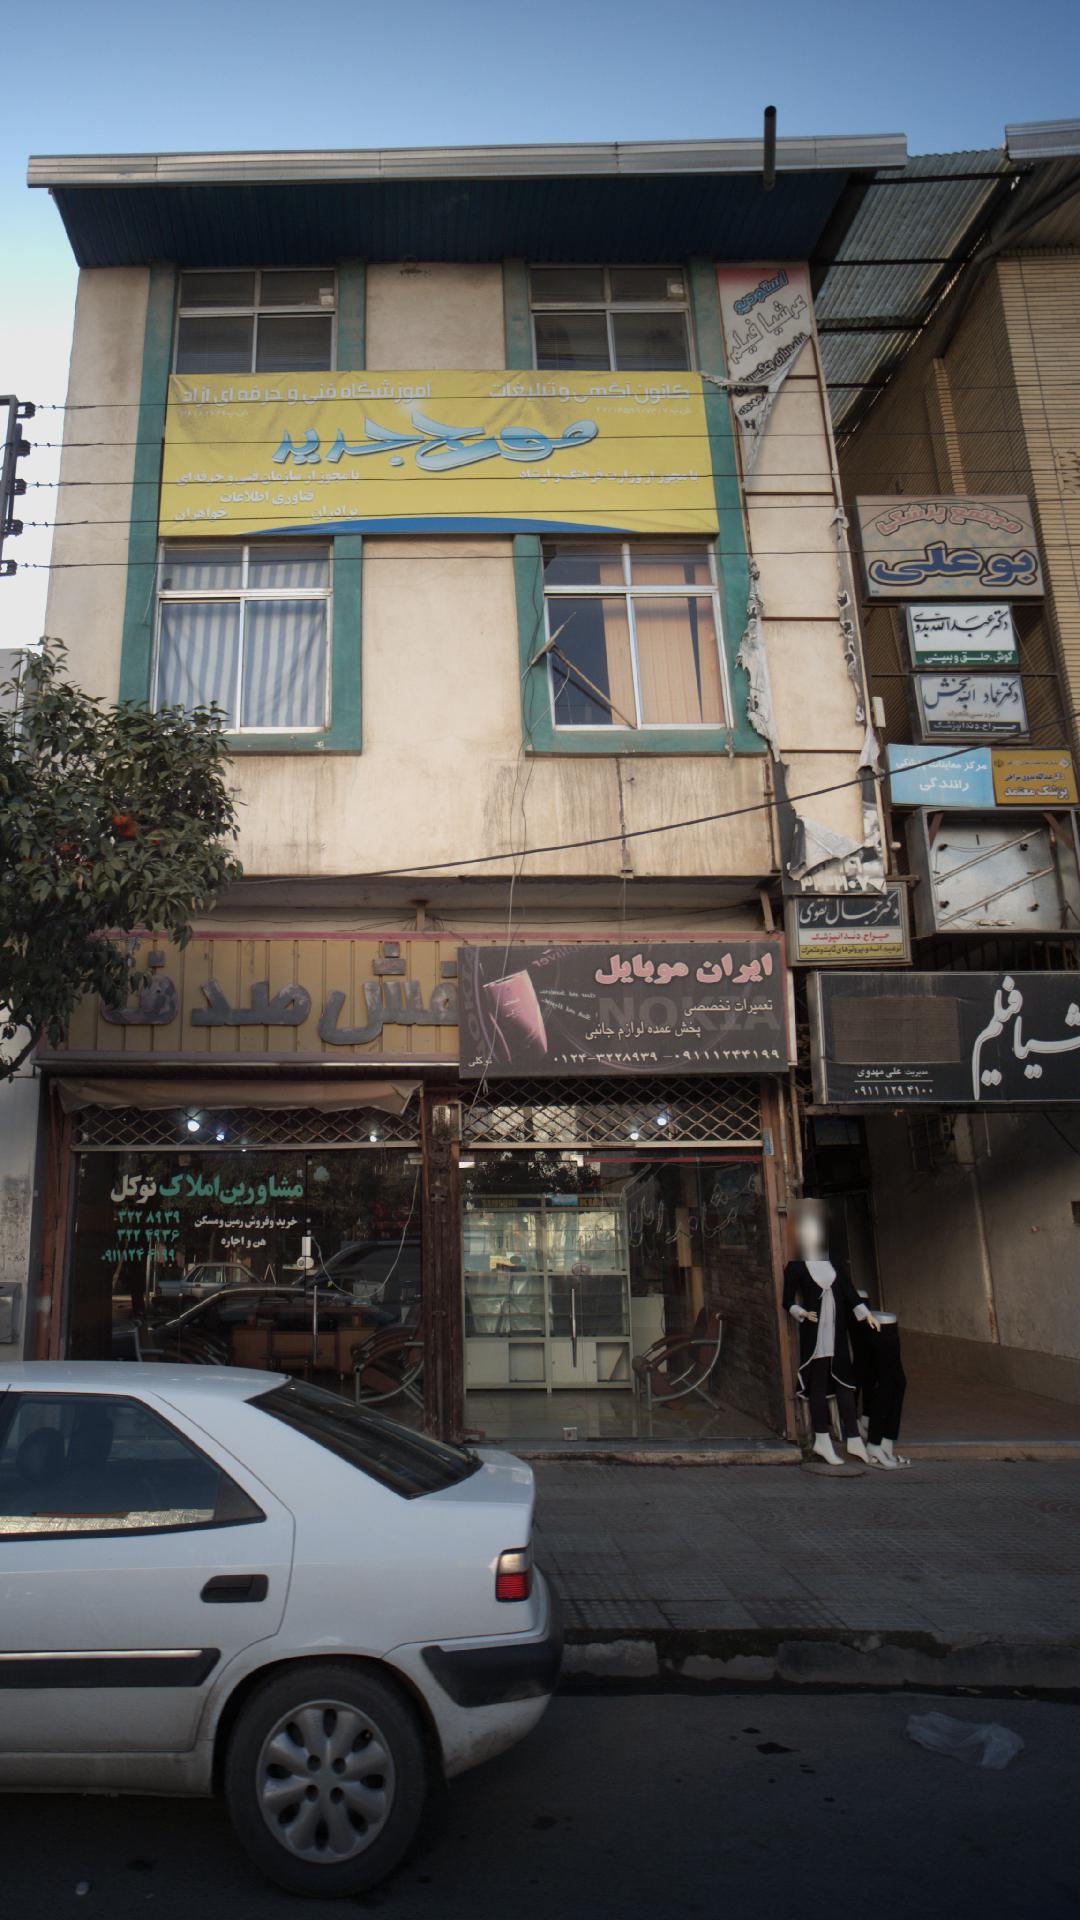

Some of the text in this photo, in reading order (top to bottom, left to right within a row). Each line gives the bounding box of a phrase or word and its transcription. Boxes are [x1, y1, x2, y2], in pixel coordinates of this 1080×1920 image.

[733, 269, 789, 316] استودیو
[730, 318, 764, 365] فیلم
[287, 387, 299, 405] و
[303, 383, 336, 404] فنی
[489, 382, 556, 400] تبلیغات
[560, 386, 570, 403] و
[635, 383, 690, 404] کانون
[271, 410, 599, 470] موج جدید
[219, 489, 315, 505] فناوری اطلاعات
[175, 506, 229, 521] خواهران
[875, 503, 1023, 536] مجتمع پزشکی
[869, 541, 985, 586] علی
[986, 610, 1008, 638] دکتر
[997, 680, 1018, 707] دکتر
[964, 761, 987, 771] مرکز
[919, 777, 970, 792] رانندگی
[871, 892, 900, 924] دکتر
[595, 953, 690, 985] موبایل
[696, 952, 773, 984] ایران
[599, 996, 781, 1032] NOKIA
[684, 998, 773, 1017] تعمیرات تخصصی
[585, 1021, 701, 1040] پخش عمده لوازم جانبی
[856, 1068, 884, 1078] مهدوی
[885, 1067, 902, 1078] علی
[110, 1173, 304, 1204] مشاورین املاک توکل
[276, 1216, 298, 1229] خرید
[221, 1235, 245, 1248] اجاره
